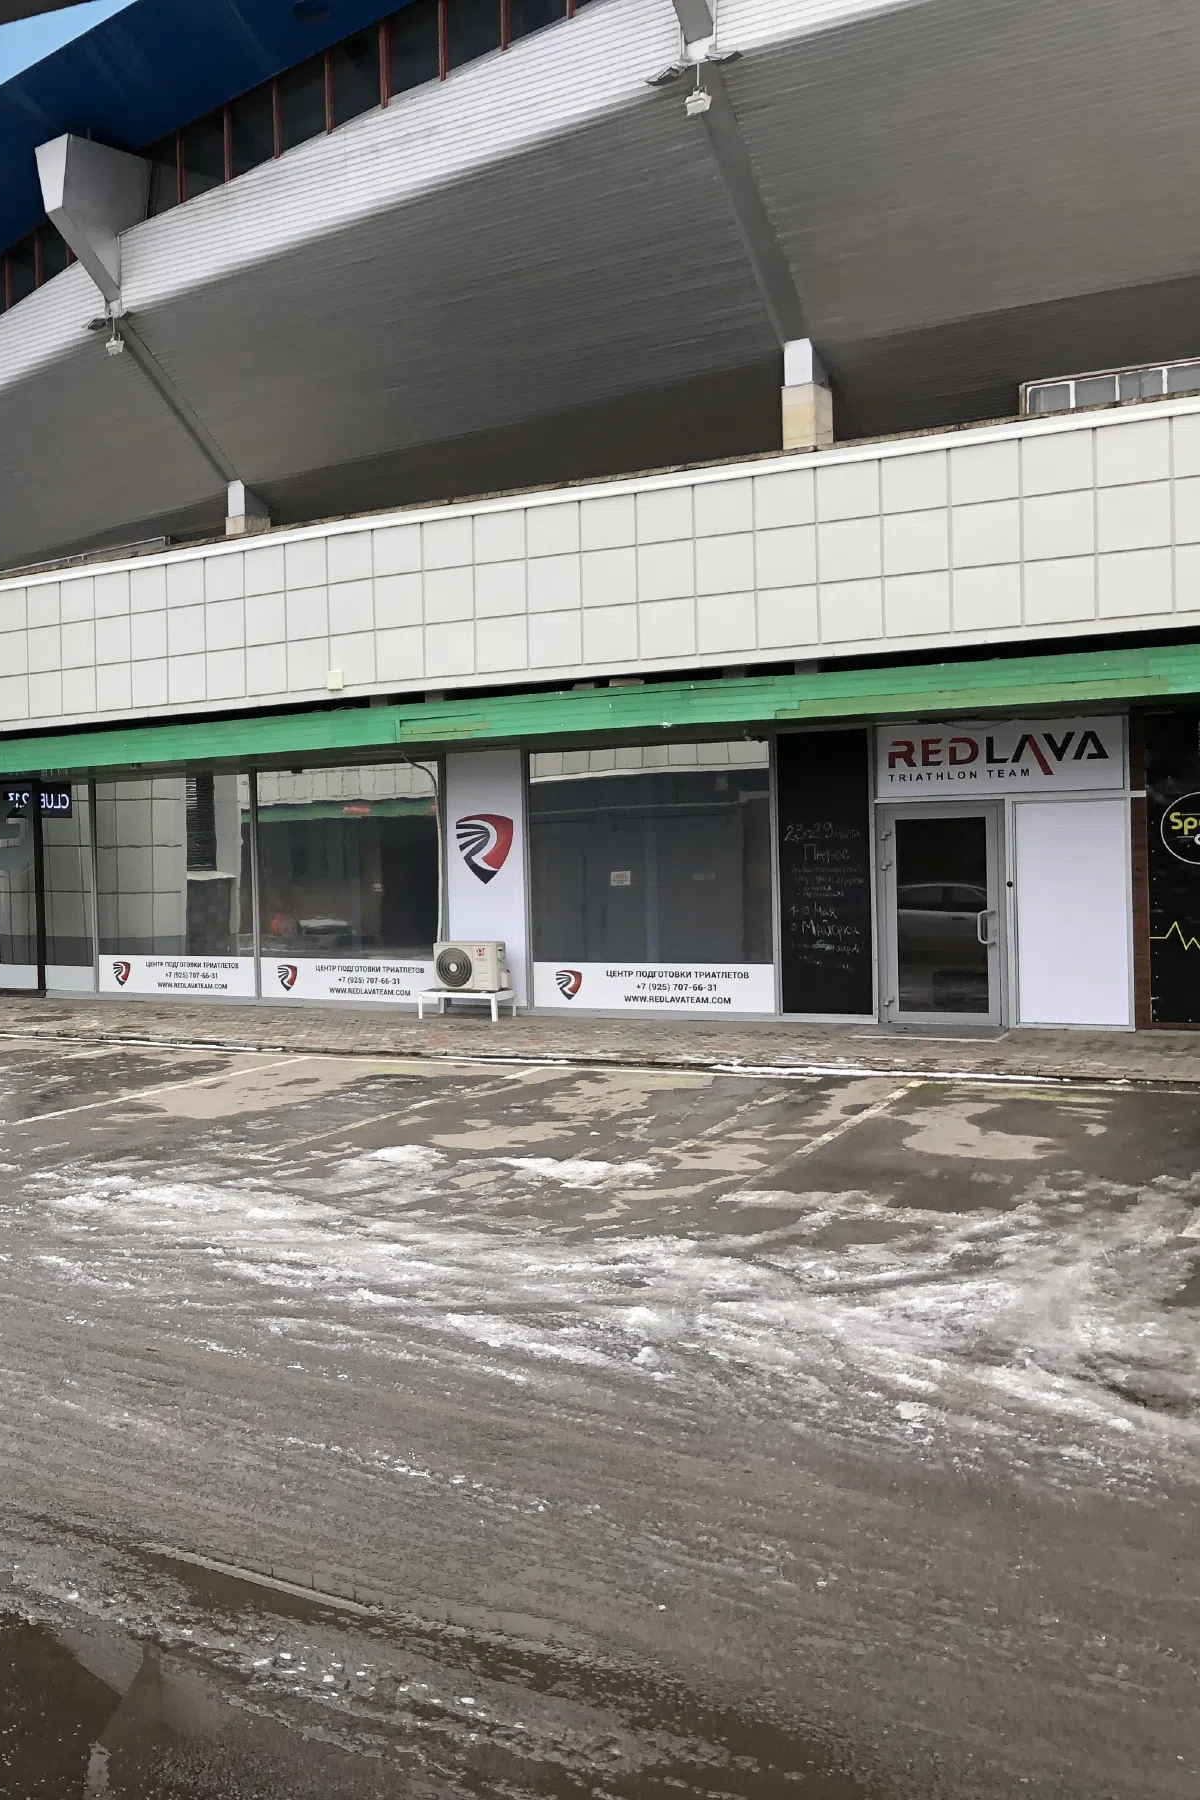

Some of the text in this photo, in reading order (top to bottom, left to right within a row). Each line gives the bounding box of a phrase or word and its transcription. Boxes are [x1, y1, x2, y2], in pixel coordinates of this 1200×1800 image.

[888, 731, 1109, 775] REDLAVA
[888, 768, 1031, 782] TRIATHLON TEAM
[1169, 811, 1200, 835] Sp
[164, 961, 202, 969] ПОДГОТОВКИ
[203, 962, 239, 970] ТРИАТЛЕТОВ
[315, 964, 425, 974] ЦЕНТР ПОДГОТОВКИ ТРИАТЛЕТОВ
[606, 970, 749, 979] ЦЕНТР ПОДГОТОВКИ ТРИАТЛЕТОВ
[347, 976, 365, 984] (925)
[366, 977, 400, 985] 707-66-31
[329, 987, 411, 996] WWW.REDLAVATEAM.COM
[648, 983, 671, 992] (925)
[673, 983, 717, 991] 707-66-31
[624, 995, 731, 1004] WWW.REDLAVATEAM.COM
